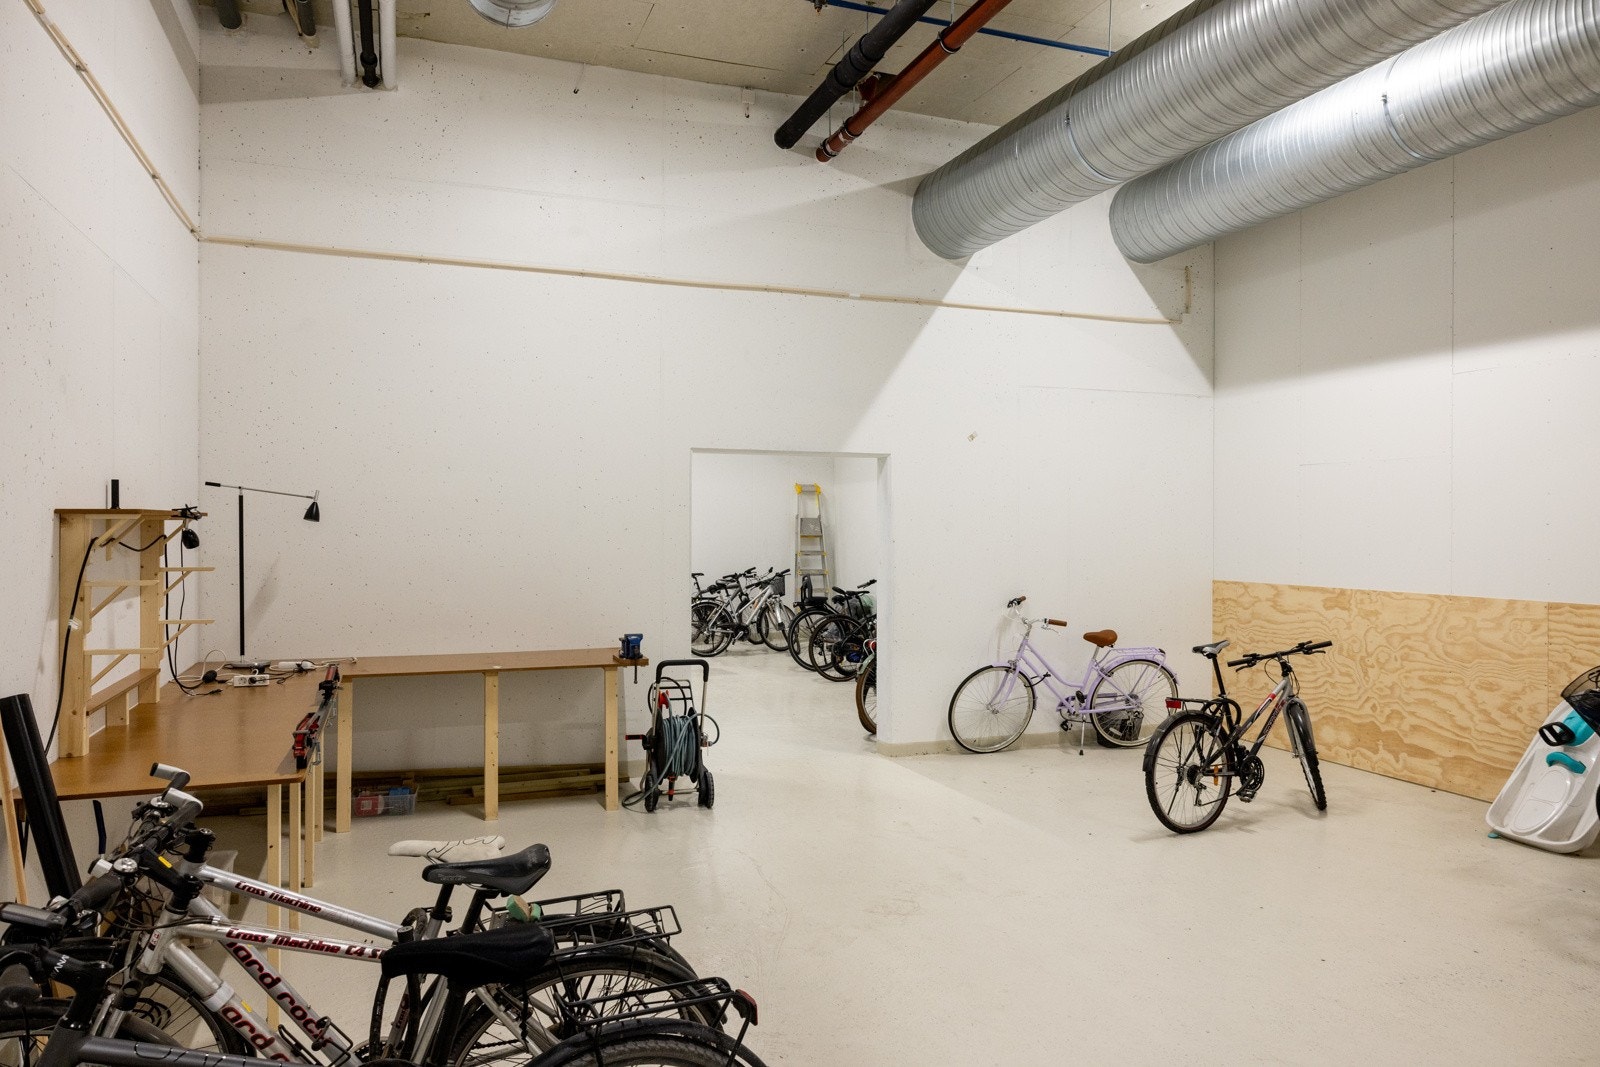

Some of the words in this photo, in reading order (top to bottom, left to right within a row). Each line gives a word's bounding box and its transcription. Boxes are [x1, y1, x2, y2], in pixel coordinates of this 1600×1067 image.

[235, 880, 268, 897] Cross
[268, 891, 321, 914] Machine
[226, 928, 269, 943] Cross
[272, 934, 341, 954] Machine
[221, 1006, 275, 1050] ard
